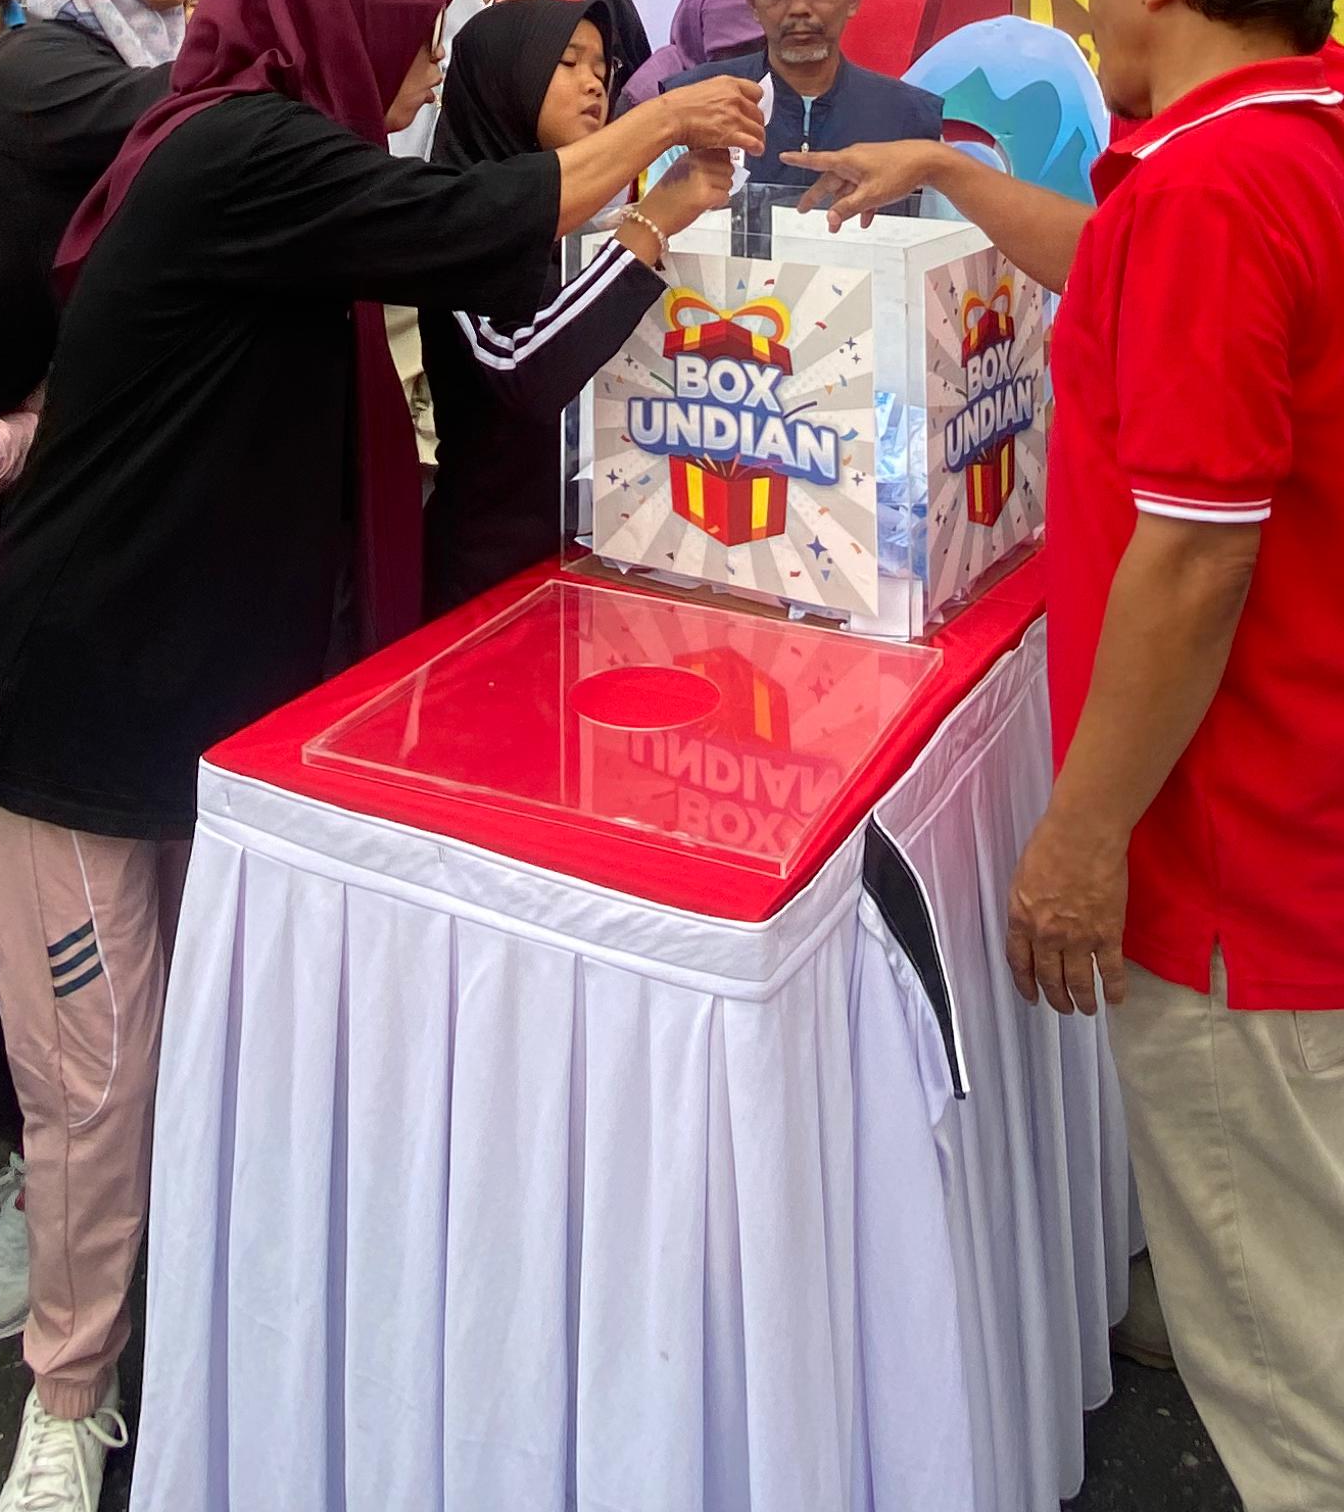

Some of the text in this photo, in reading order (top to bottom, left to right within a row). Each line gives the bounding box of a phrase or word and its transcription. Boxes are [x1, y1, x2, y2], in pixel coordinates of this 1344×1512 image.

[675, 354, 783, 413] BOX
[967, 340, 1013, 402] BOX
[629, 399, 837, 480] UNDIAN
[947, 378, 1033, 467] UNDIAN
